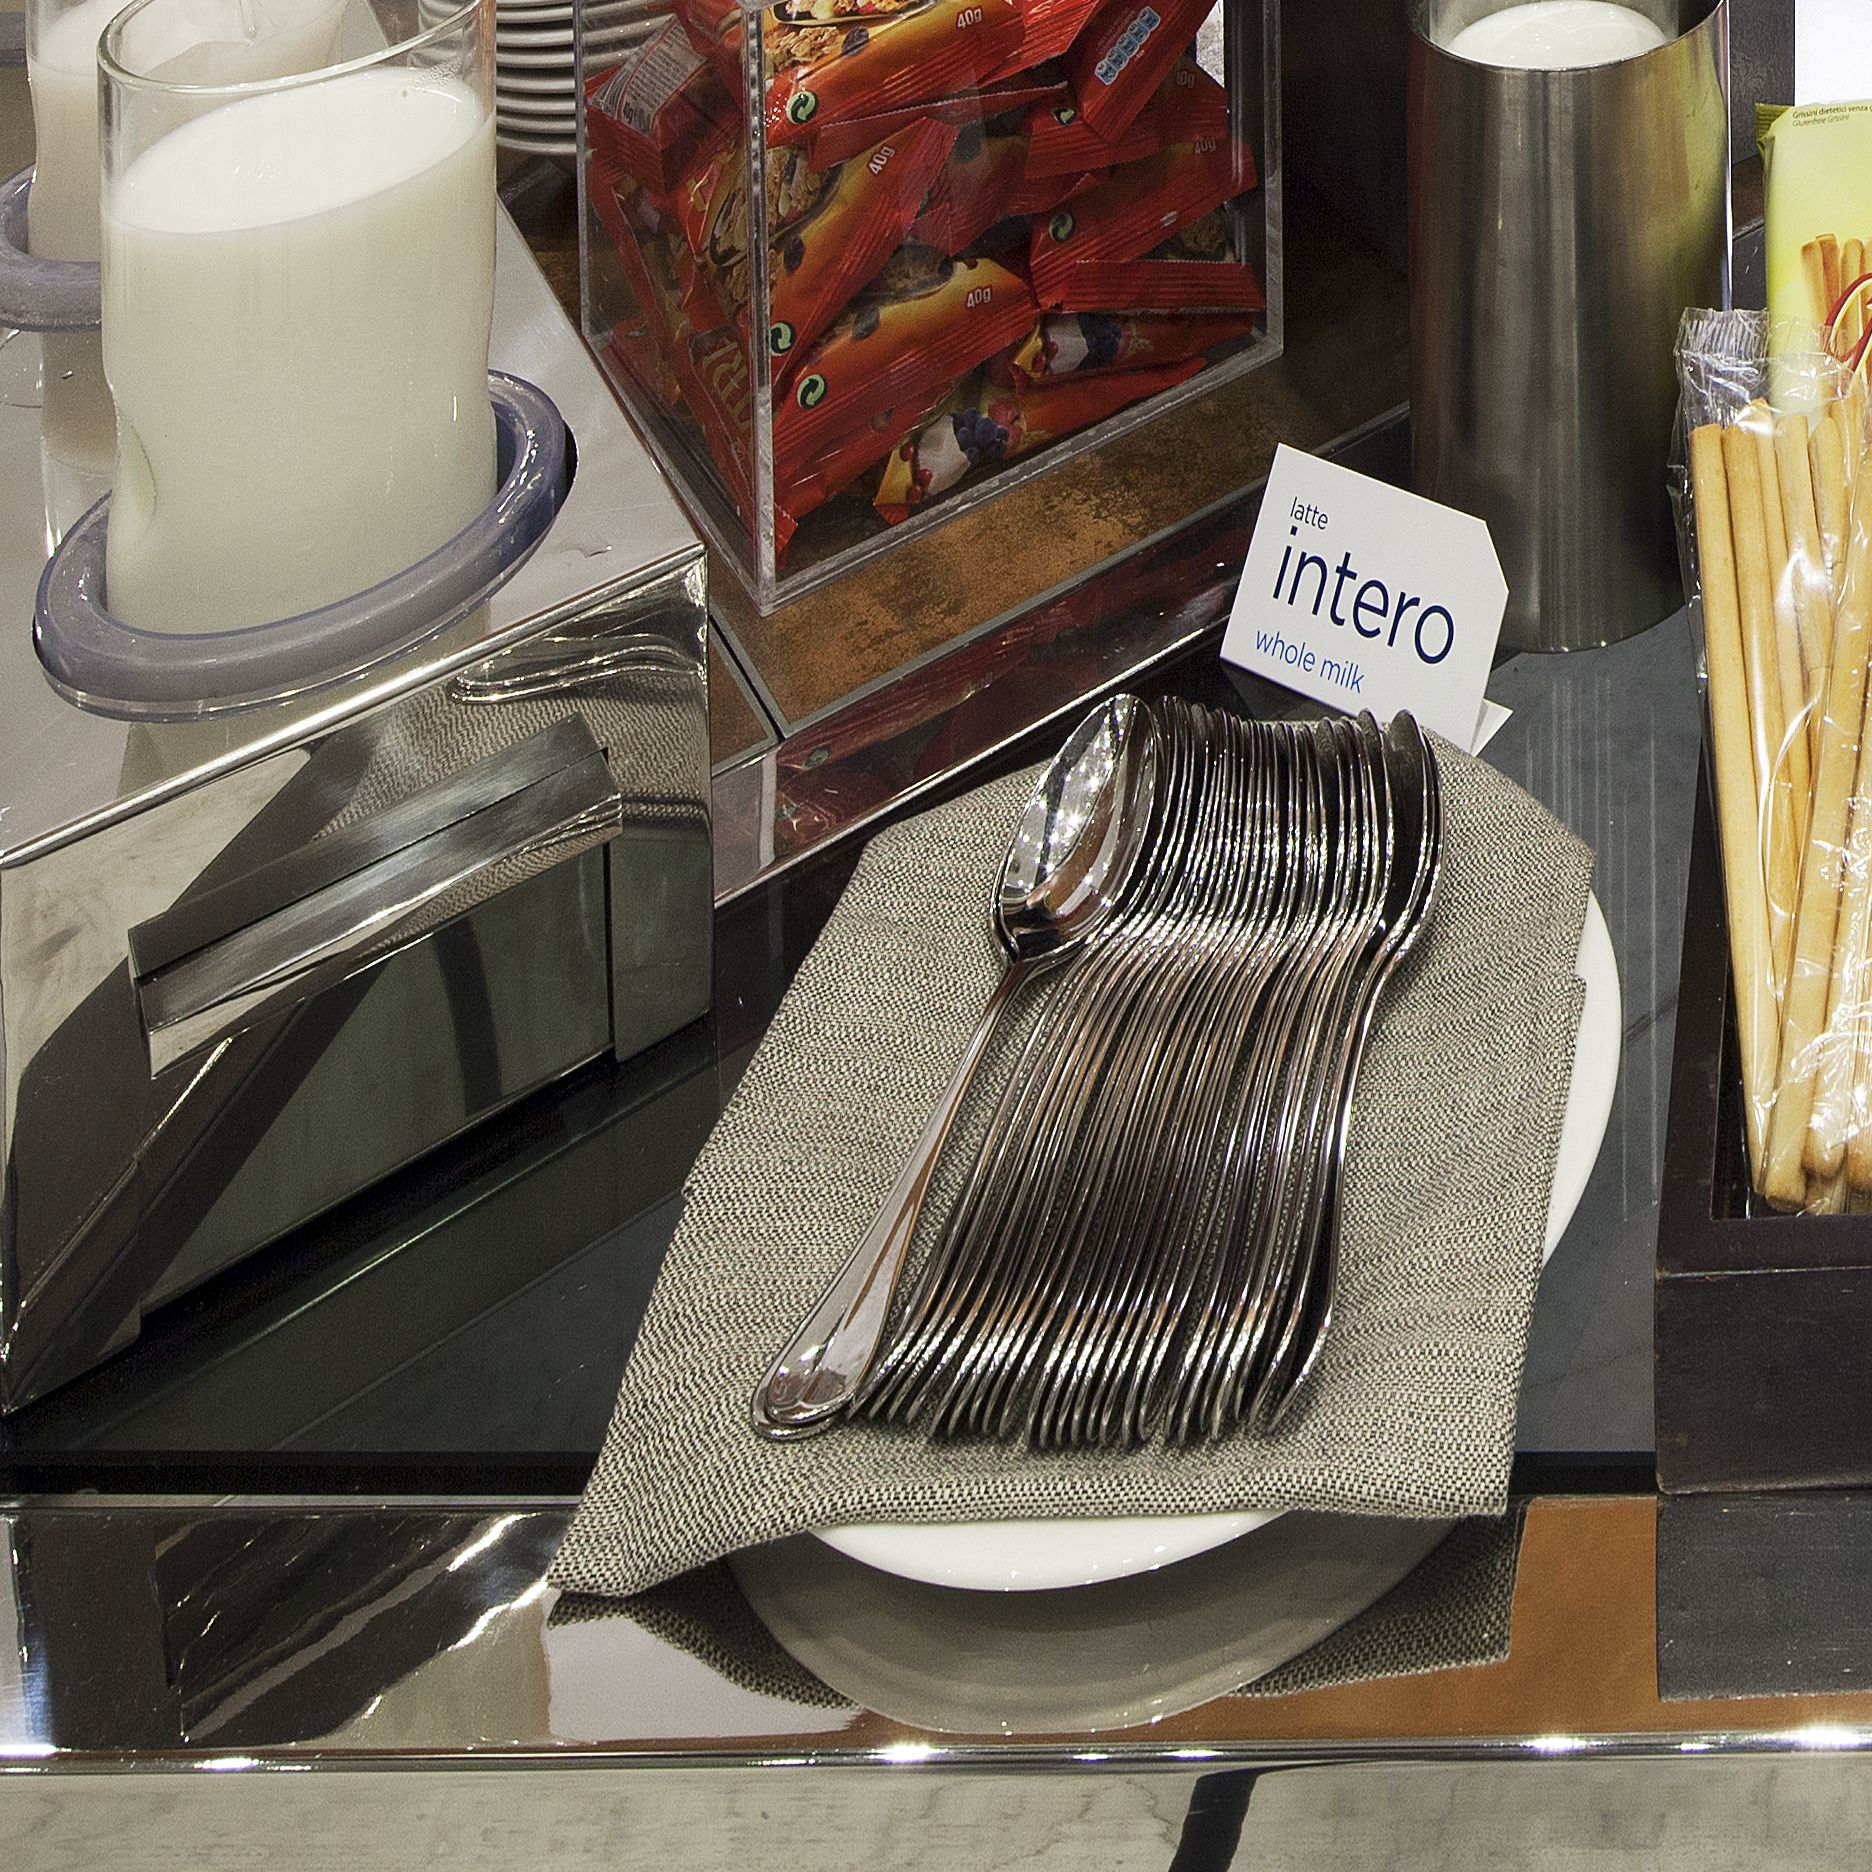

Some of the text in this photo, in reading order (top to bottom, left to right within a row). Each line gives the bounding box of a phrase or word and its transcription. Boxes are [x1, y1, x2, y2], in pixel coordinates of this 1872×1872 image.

[956, 7, 983, 30] 40g
[1792, 108, 1817, 118] Grissini
[868, 145, 896, 176] 40g
[965, 285, 993, 311] 40g
[1290, 496, 1329, 530] latte
[1272, 525, 1455, 665] intero
[1256, 630, 1365, 694] whole milk
